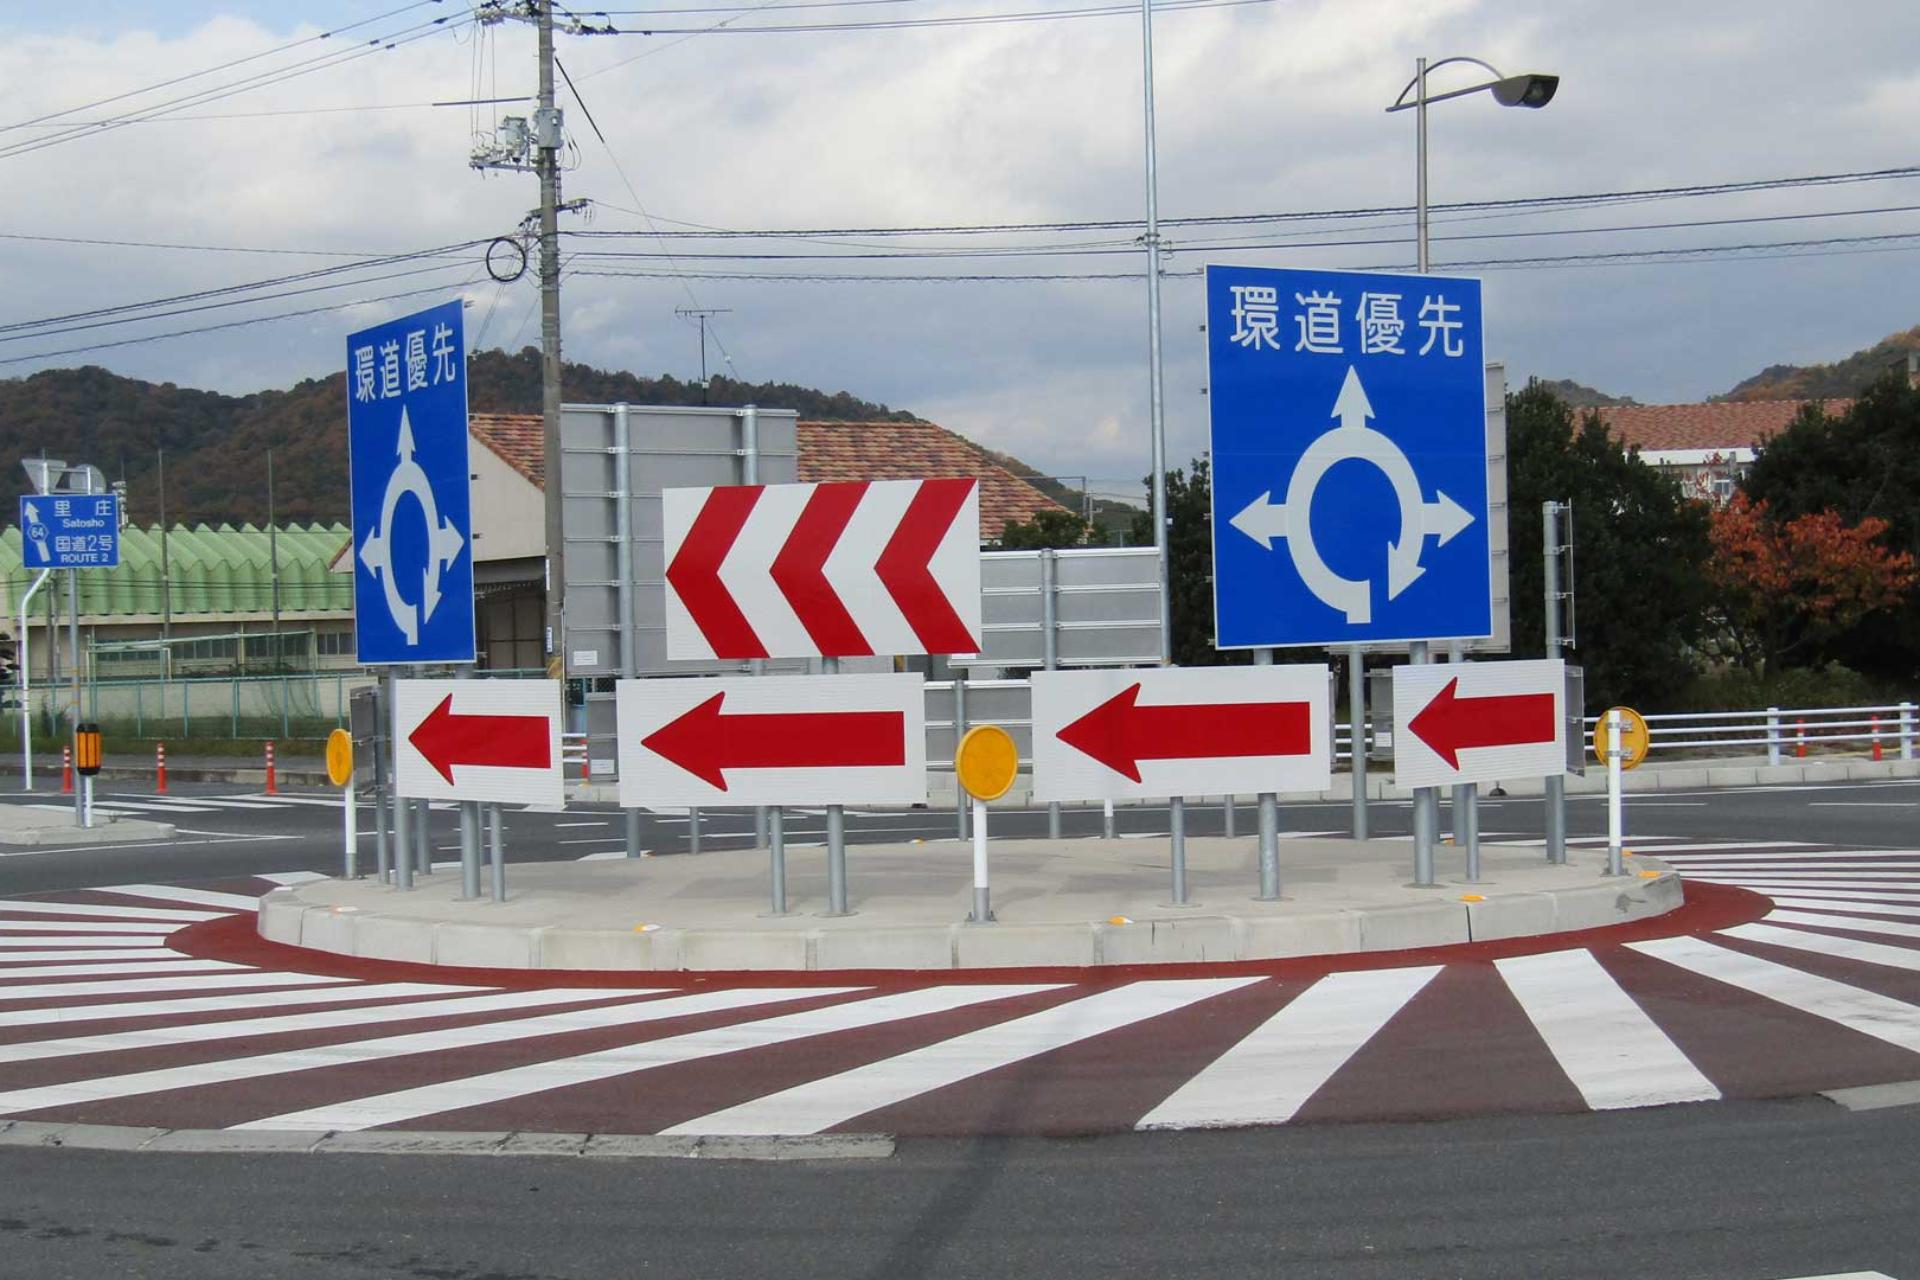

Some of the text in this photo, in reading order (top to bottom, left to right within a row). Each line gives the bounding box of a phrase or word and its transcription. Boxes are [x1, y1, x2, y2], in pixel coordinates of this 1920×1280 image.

[1229, 286, 1464, 357] 環道優先
[355, 321, 456, 403] 環道優先
[63, 519, 105, 528] Satosho
[31, 527, 44, 538] 64
[55, 534, 114, 552] 国道2号
[60, 553, 109, 563] ROUTE 2
